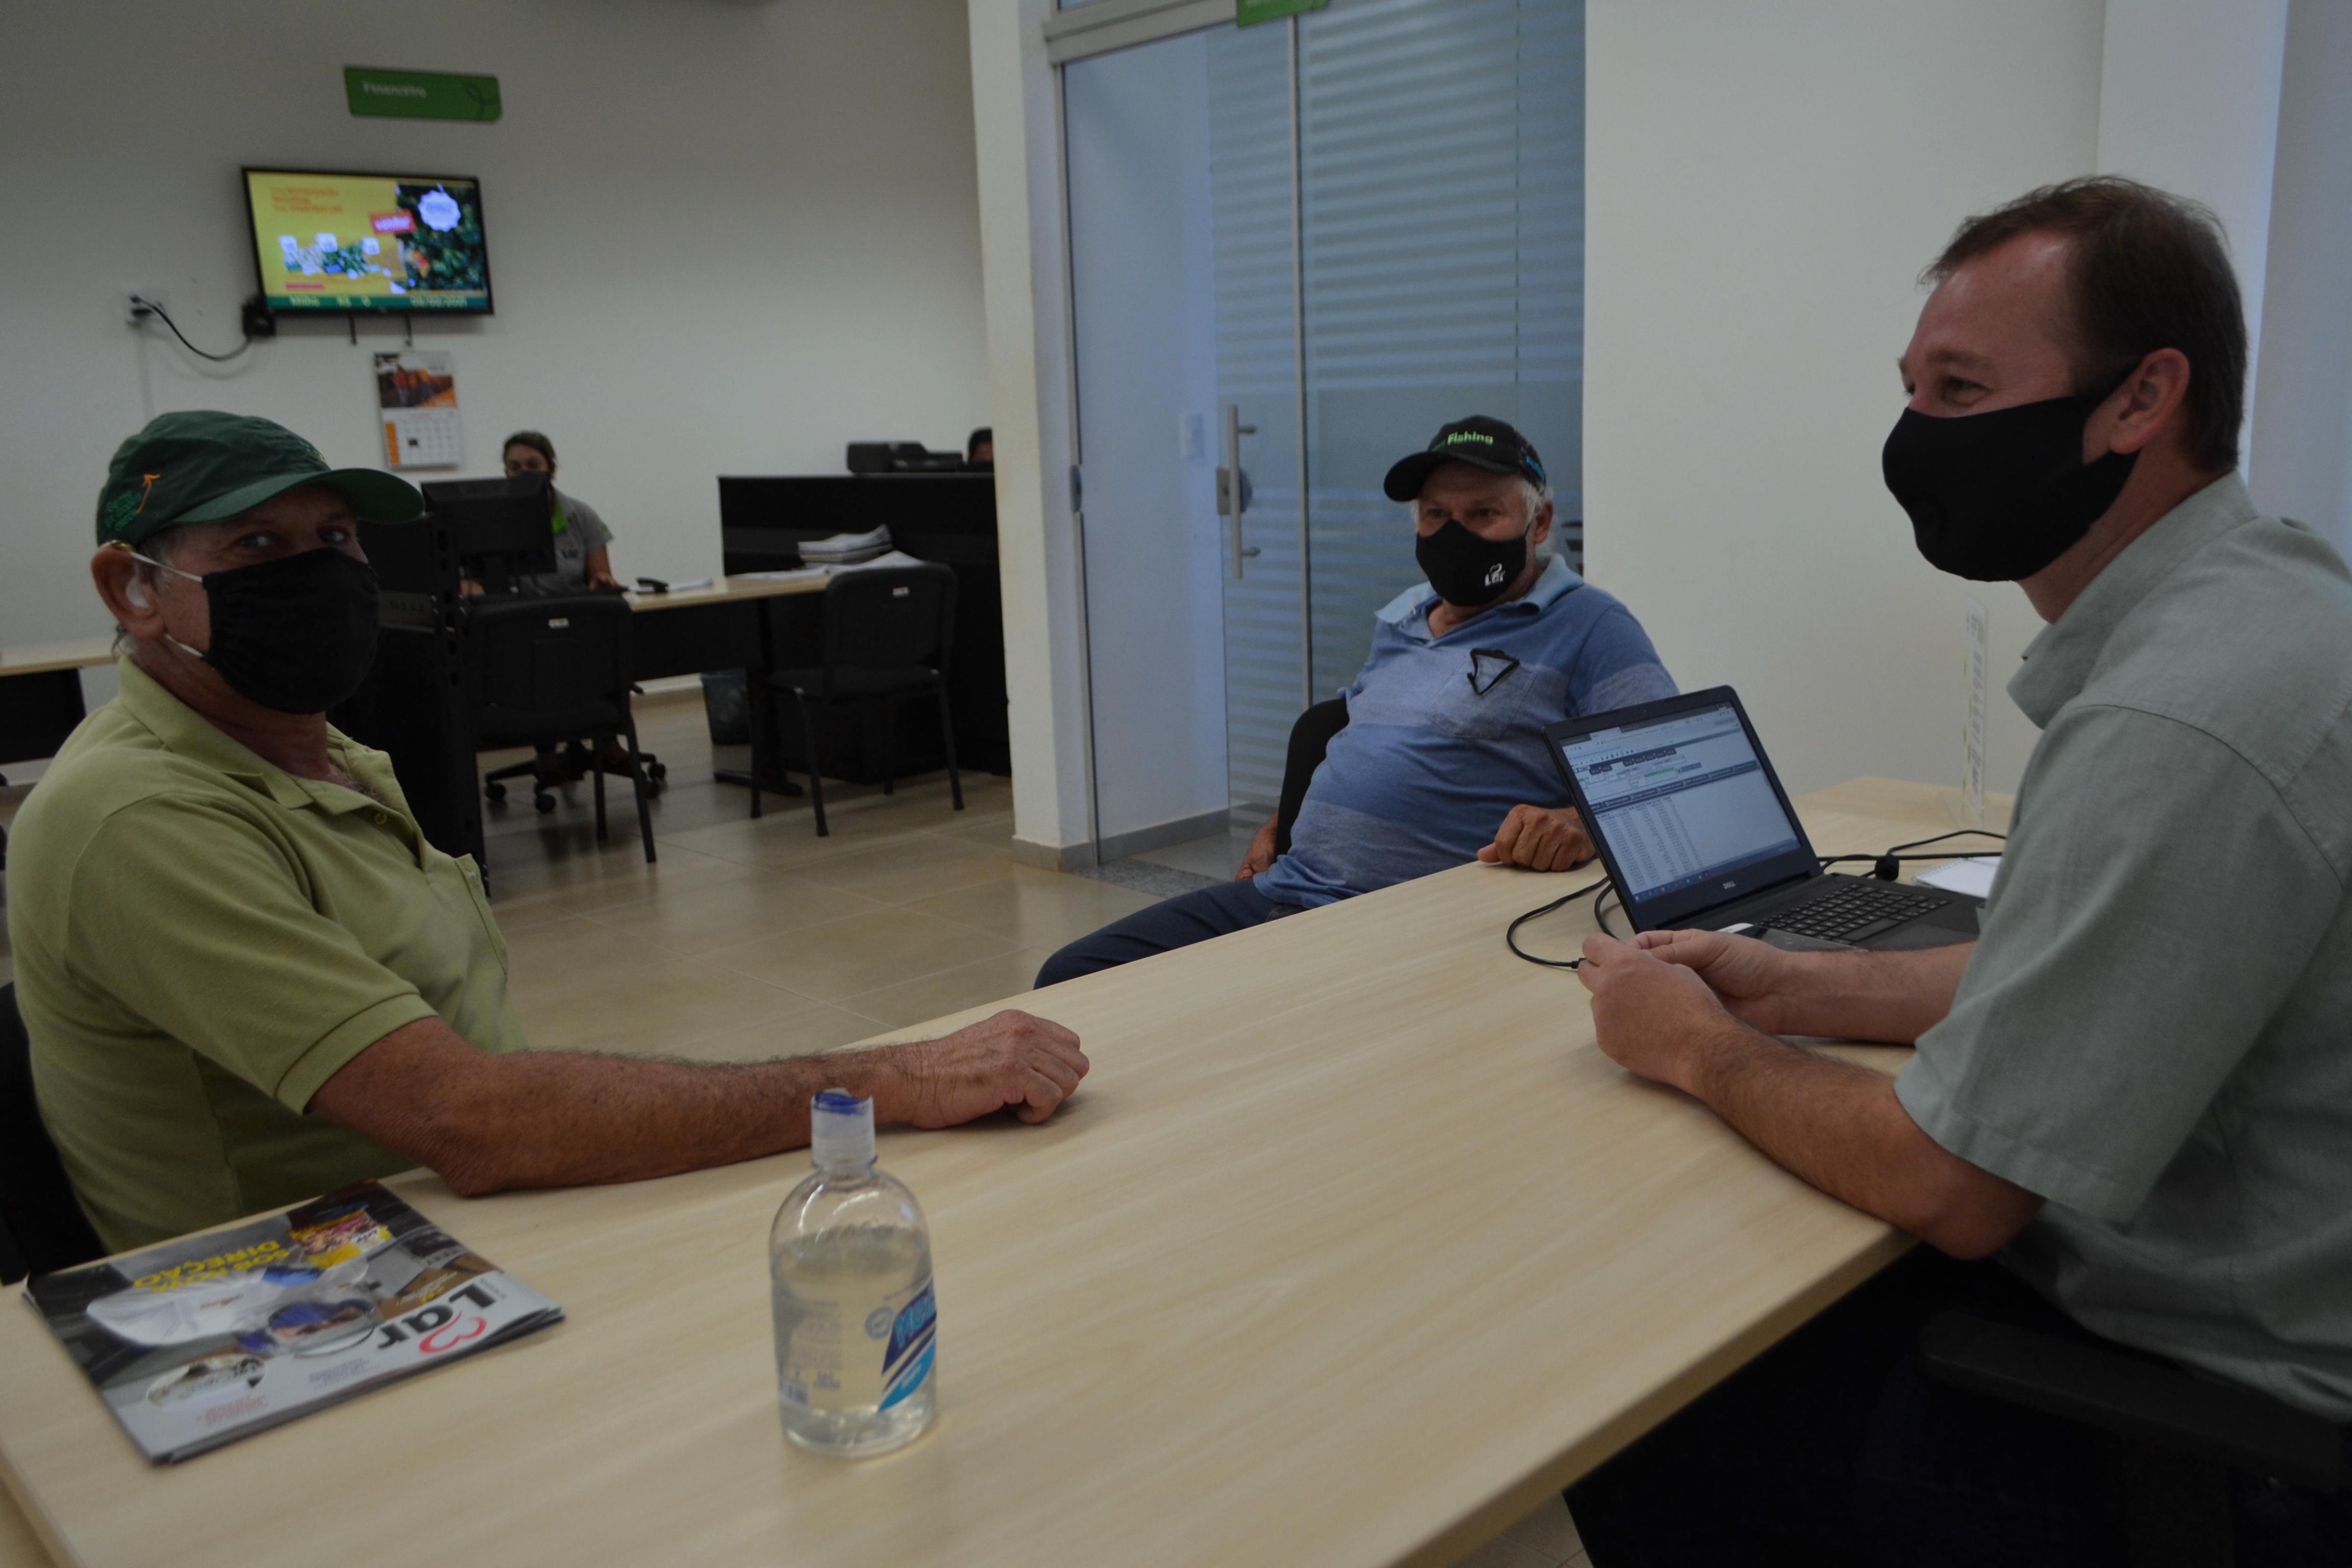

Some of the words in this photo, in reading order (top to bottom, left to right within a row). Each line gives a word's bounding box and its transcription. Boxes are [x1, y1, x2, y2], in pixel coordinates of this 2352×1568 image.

[1447, 431, 1493, 446] Fishing
[132, 1241, 281, 1289] DIREÇÃO
[376, 1284, 497, 1350] Lar
